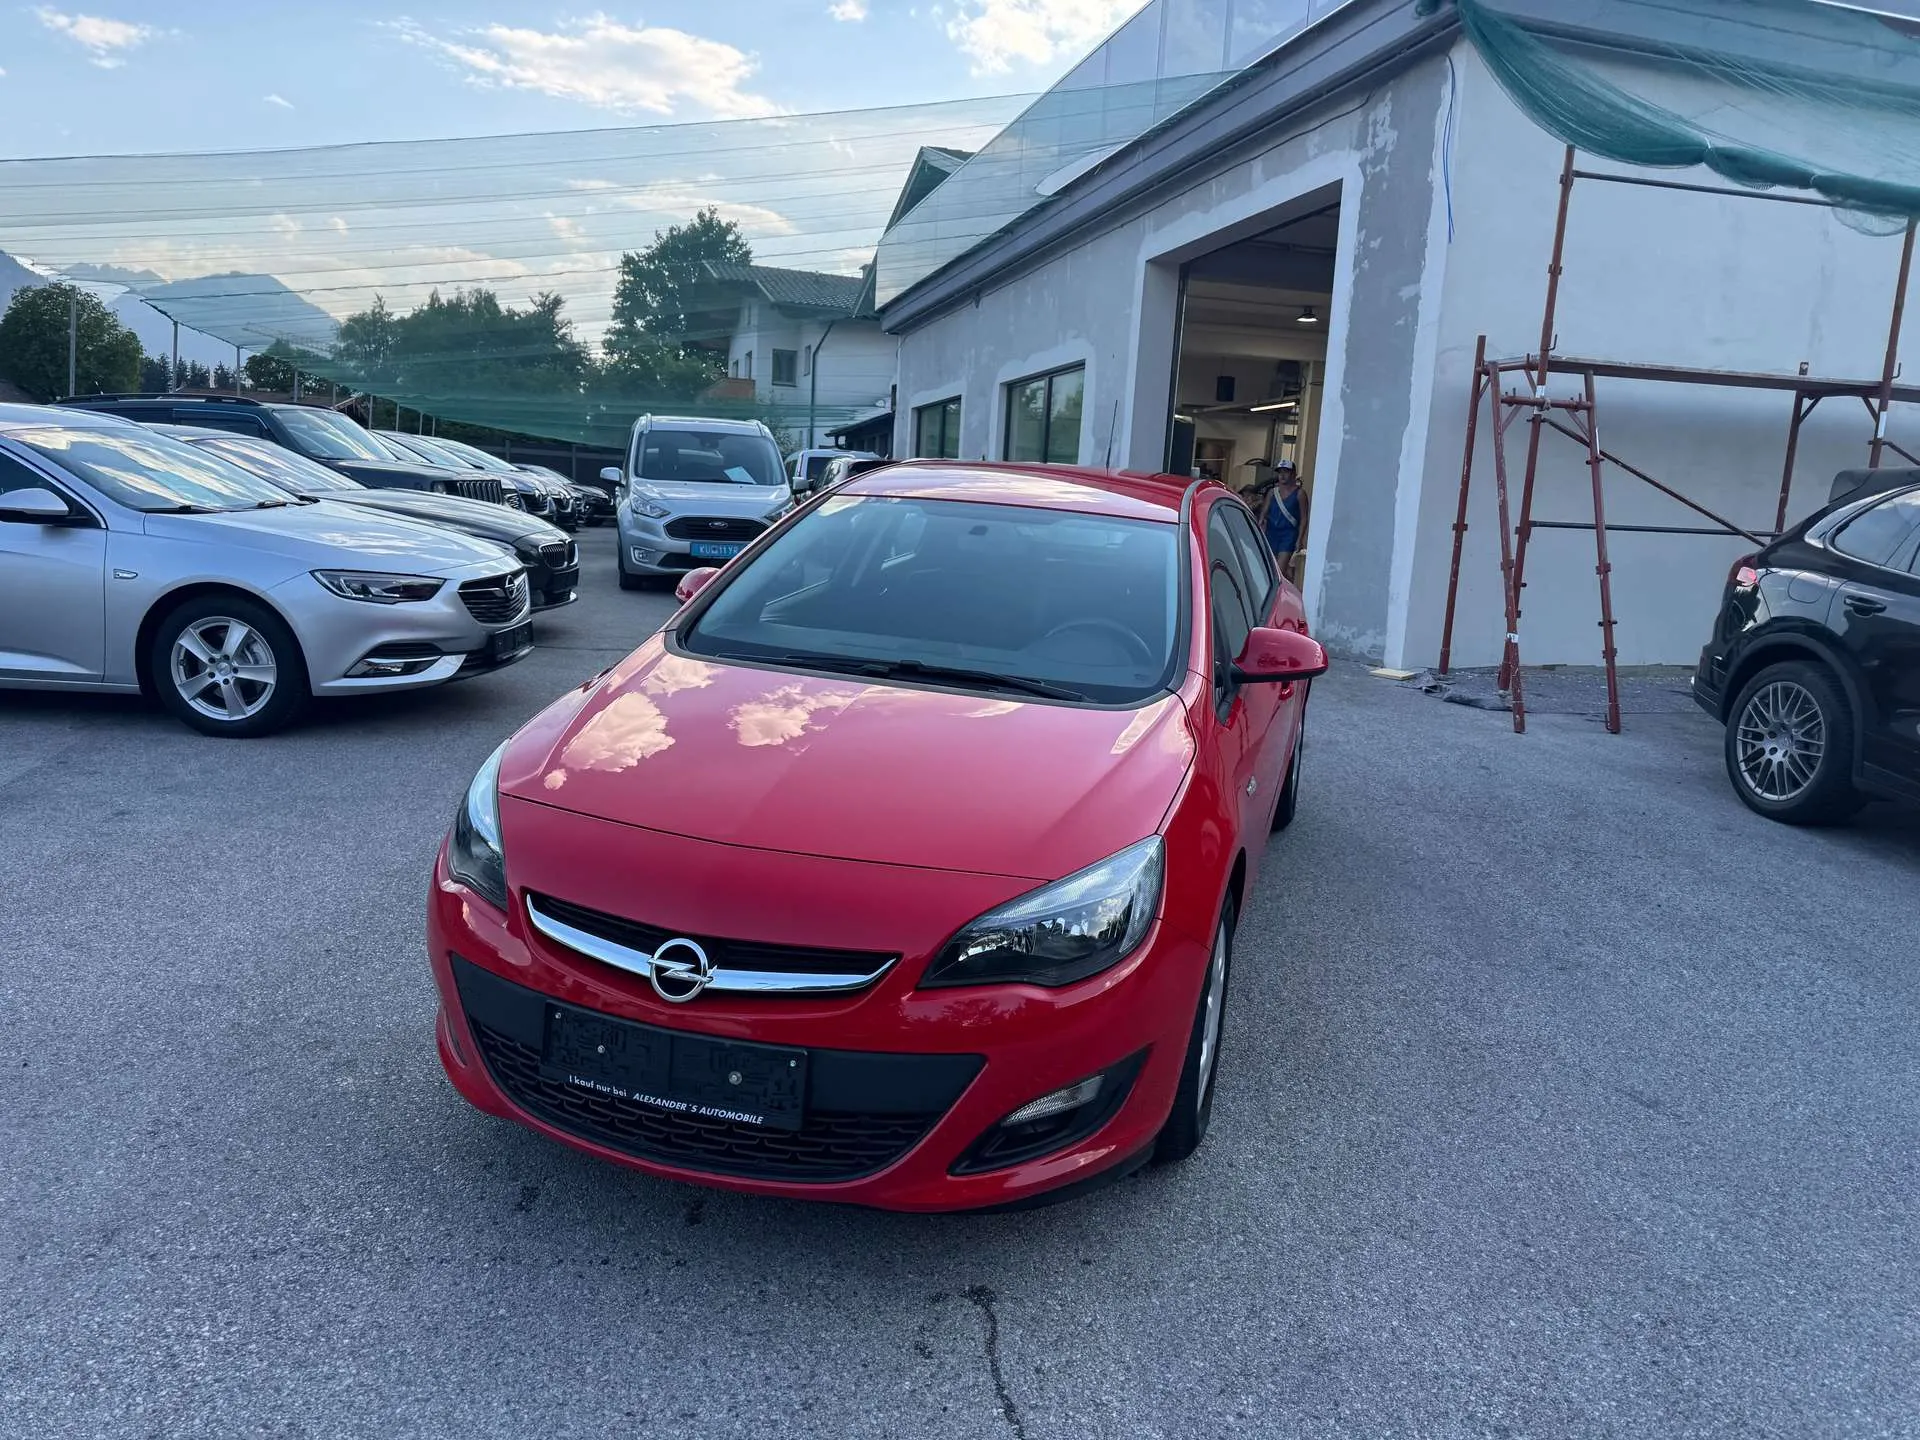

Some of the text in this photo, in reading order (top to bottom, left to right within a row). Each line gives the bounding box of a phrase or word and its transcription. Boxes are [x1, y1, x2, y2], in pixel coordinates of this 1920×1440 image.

[574, 1075, 594, 1088] kauf
[596, 1084, 611, 1093] nur
[613, 1086, 627, 1097] bei
[699, 1107, 764, 1125] AUTOMOBILE
